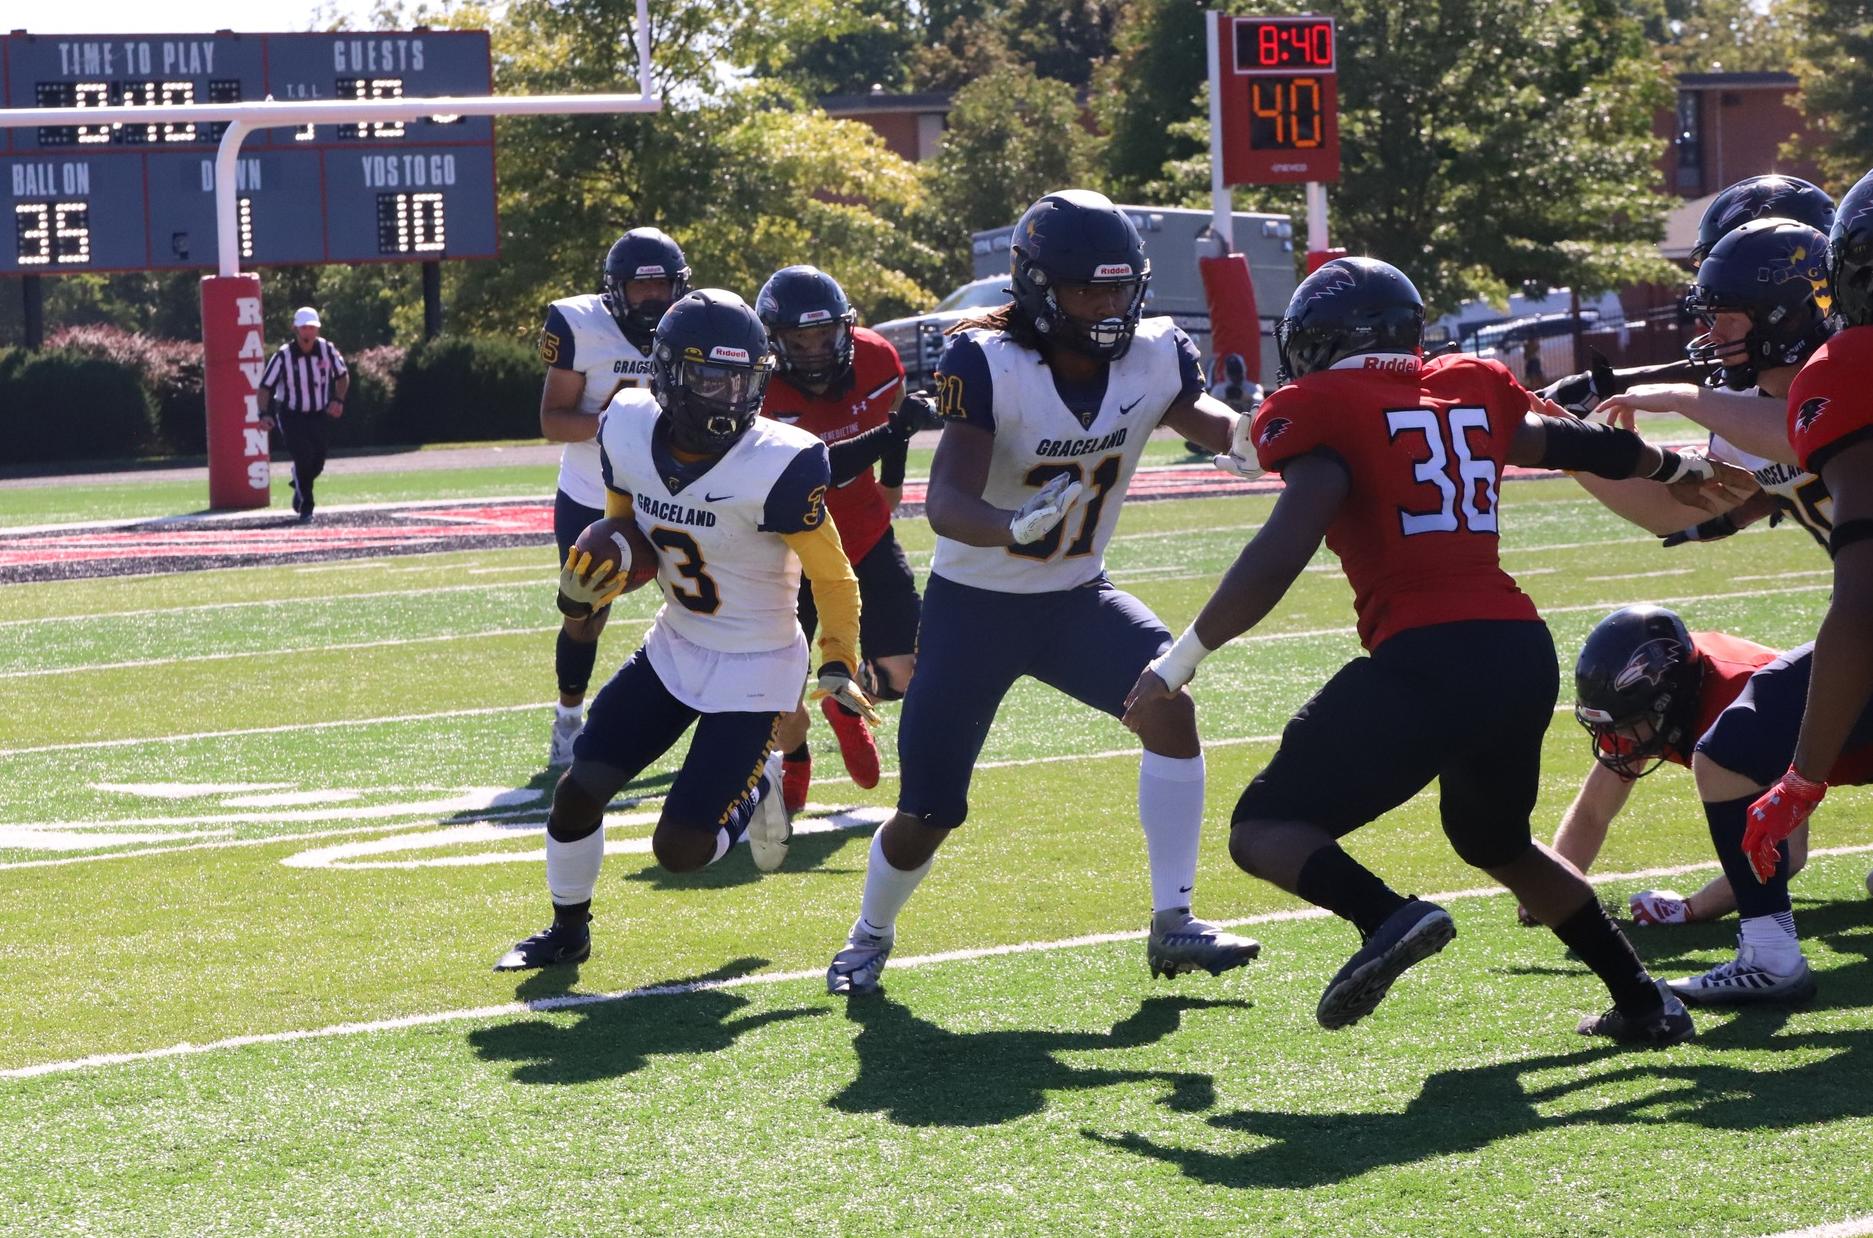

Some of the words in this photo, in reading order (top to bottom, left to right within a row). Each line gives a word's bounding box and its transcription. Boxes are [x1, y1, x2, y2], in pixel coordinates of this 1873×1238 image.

[59, 43, 113, 75] TIME
[124, 41, 151, 75] TO
[163, 41, 215, 74] PLAY
[333, 40, 424, 71] GUESTS
[1258, 25, 1331, 65] 8:40
[1252, 79, 1321, 147] 40
[12, 163, 56, 196] BALL
[62, 162, 90, 195] ON
[201, 159, 261, 192] DWN
[362, 155, 399, 188] YDS
[403, 155, 426, 187] TO
[430, 154, 456, 186] GO
[15, 202, 90, 264] 35
[396, 193, 445, 252] 10
[1100, 266, 1130, 275] Riddell
[539, 328, 560, 364] 5
[715, 347, 746, 359] Riddell
[1036, 427, 1128, 457] GRACELAND
[1383, 405, 1499, 538] 36
[637, 492, 716, 528] GRACELAND
[803, 484, 828, 526] 3
[649, 524, 722, 617] 3
